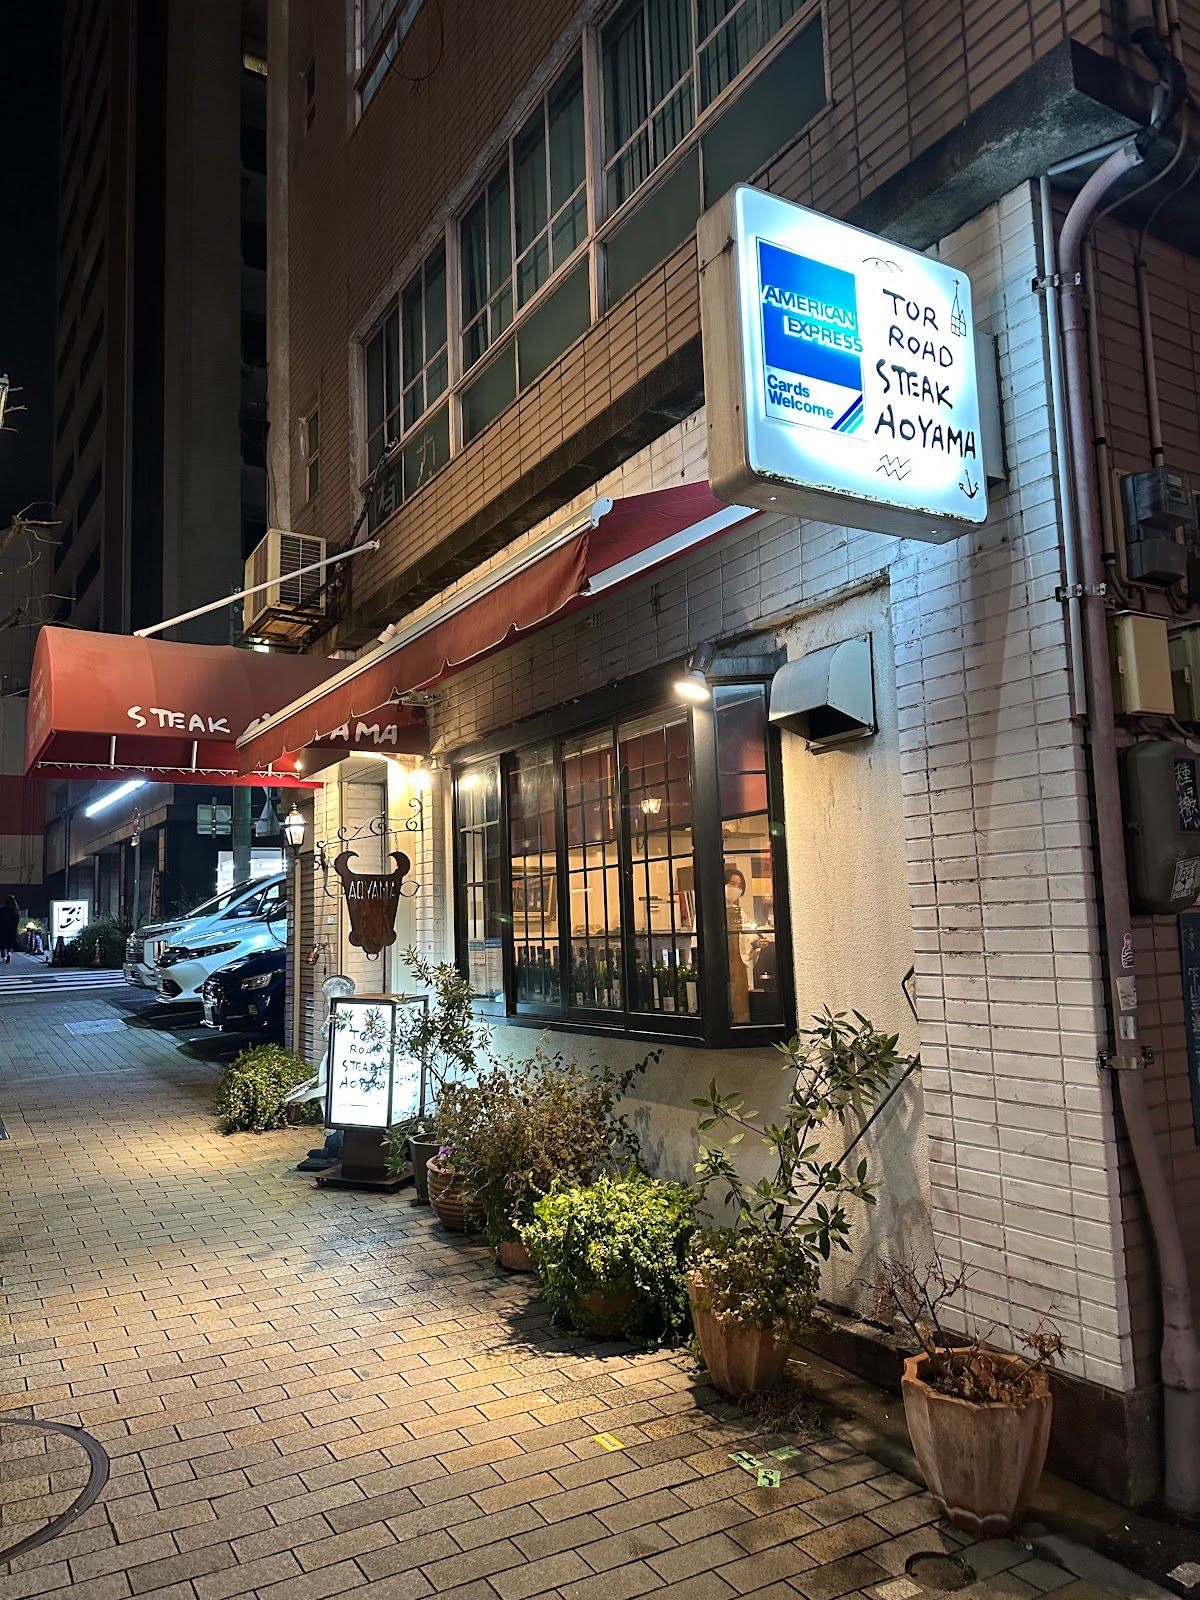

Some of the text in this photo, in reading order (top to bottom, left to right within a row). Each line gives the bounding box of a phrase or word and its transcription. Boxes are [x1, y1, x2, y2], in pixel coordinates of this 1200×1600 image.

[762, 285, 856, 329] AMERICAN
[883, 289, 938, 331] TOR
[784, 315, 863, 356] EXPRESS
[888, 325, 953, 367] ROAD
[767, 374, 810, 397] Cards
[768, 389, 834, 418] Welcome
[876, 359, 953, 409] STEAK
[874, 404, 976, 459] AOYAMA
[128, 706, 231, 733] STEAK
[348, 880, 397, 900] AOYAMA
